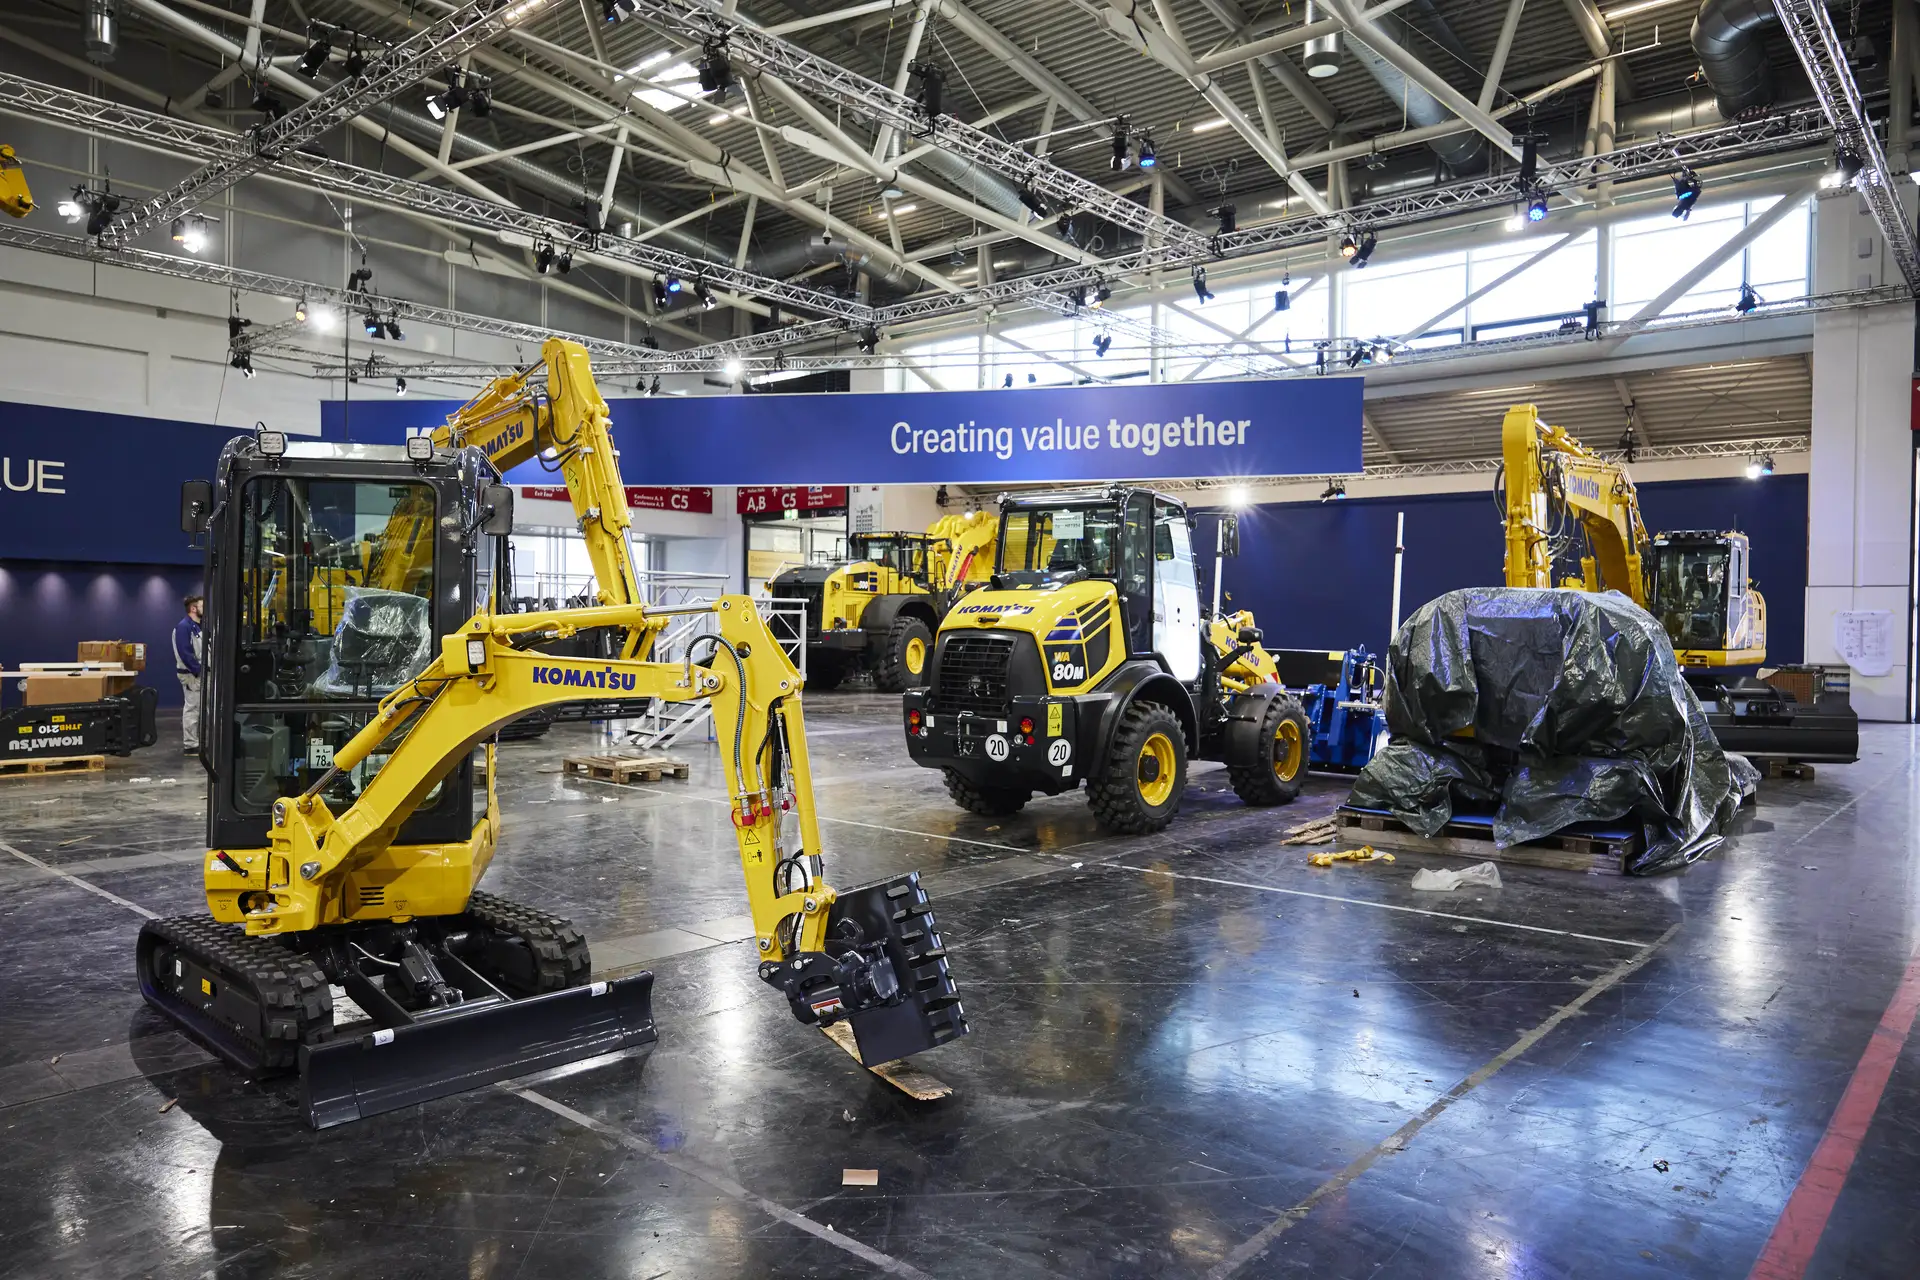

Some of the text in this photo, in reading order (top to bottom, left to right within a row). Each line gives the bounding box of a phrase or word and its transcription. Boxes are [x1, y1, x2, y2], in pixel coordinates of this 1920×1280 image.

[480, 420, 524, 457] OMATSU
[891, 413, 1251, 460] Creating value together
[0, 456, 66, 494] UE
[671, 494, 689, 509] C5
[781, 493, 796, 508] C5
[957, 604, 1035, 615] KOMATSU
[1053, 652, 1071, 662] WA
[532, 666, 636, 691] KOMATSU
[1052, 663, 1084, 681] 80M
[8, 735, 84, 751] KOMATSU
[990, 739, 1005, 756] 20
[315, 754, 327, 767] 78
[1052, 744, 1067, 761] 20
